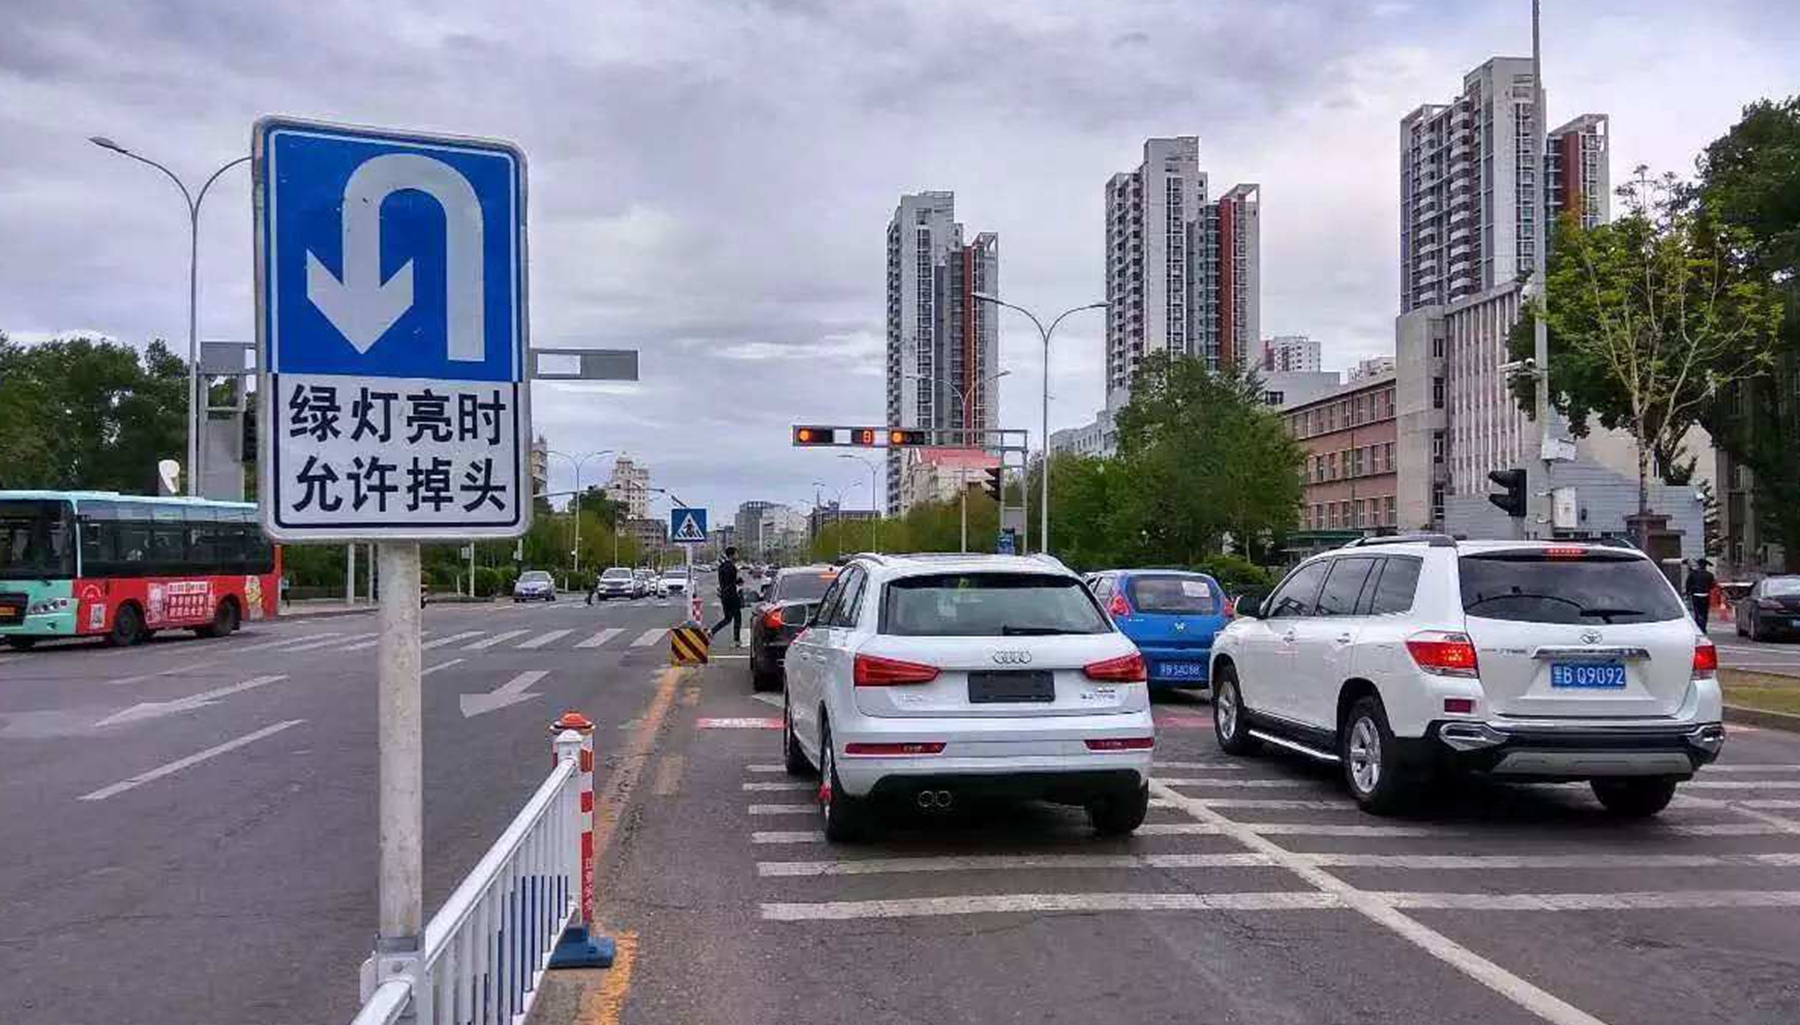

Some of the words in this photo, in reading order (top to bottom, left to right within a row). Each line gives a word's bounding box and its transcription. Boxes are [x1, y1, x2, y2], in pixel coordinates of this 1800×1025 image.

[289, 383, 506, 446] 绿灯亮时
[291, 455, 507, 513] 允许掉头
